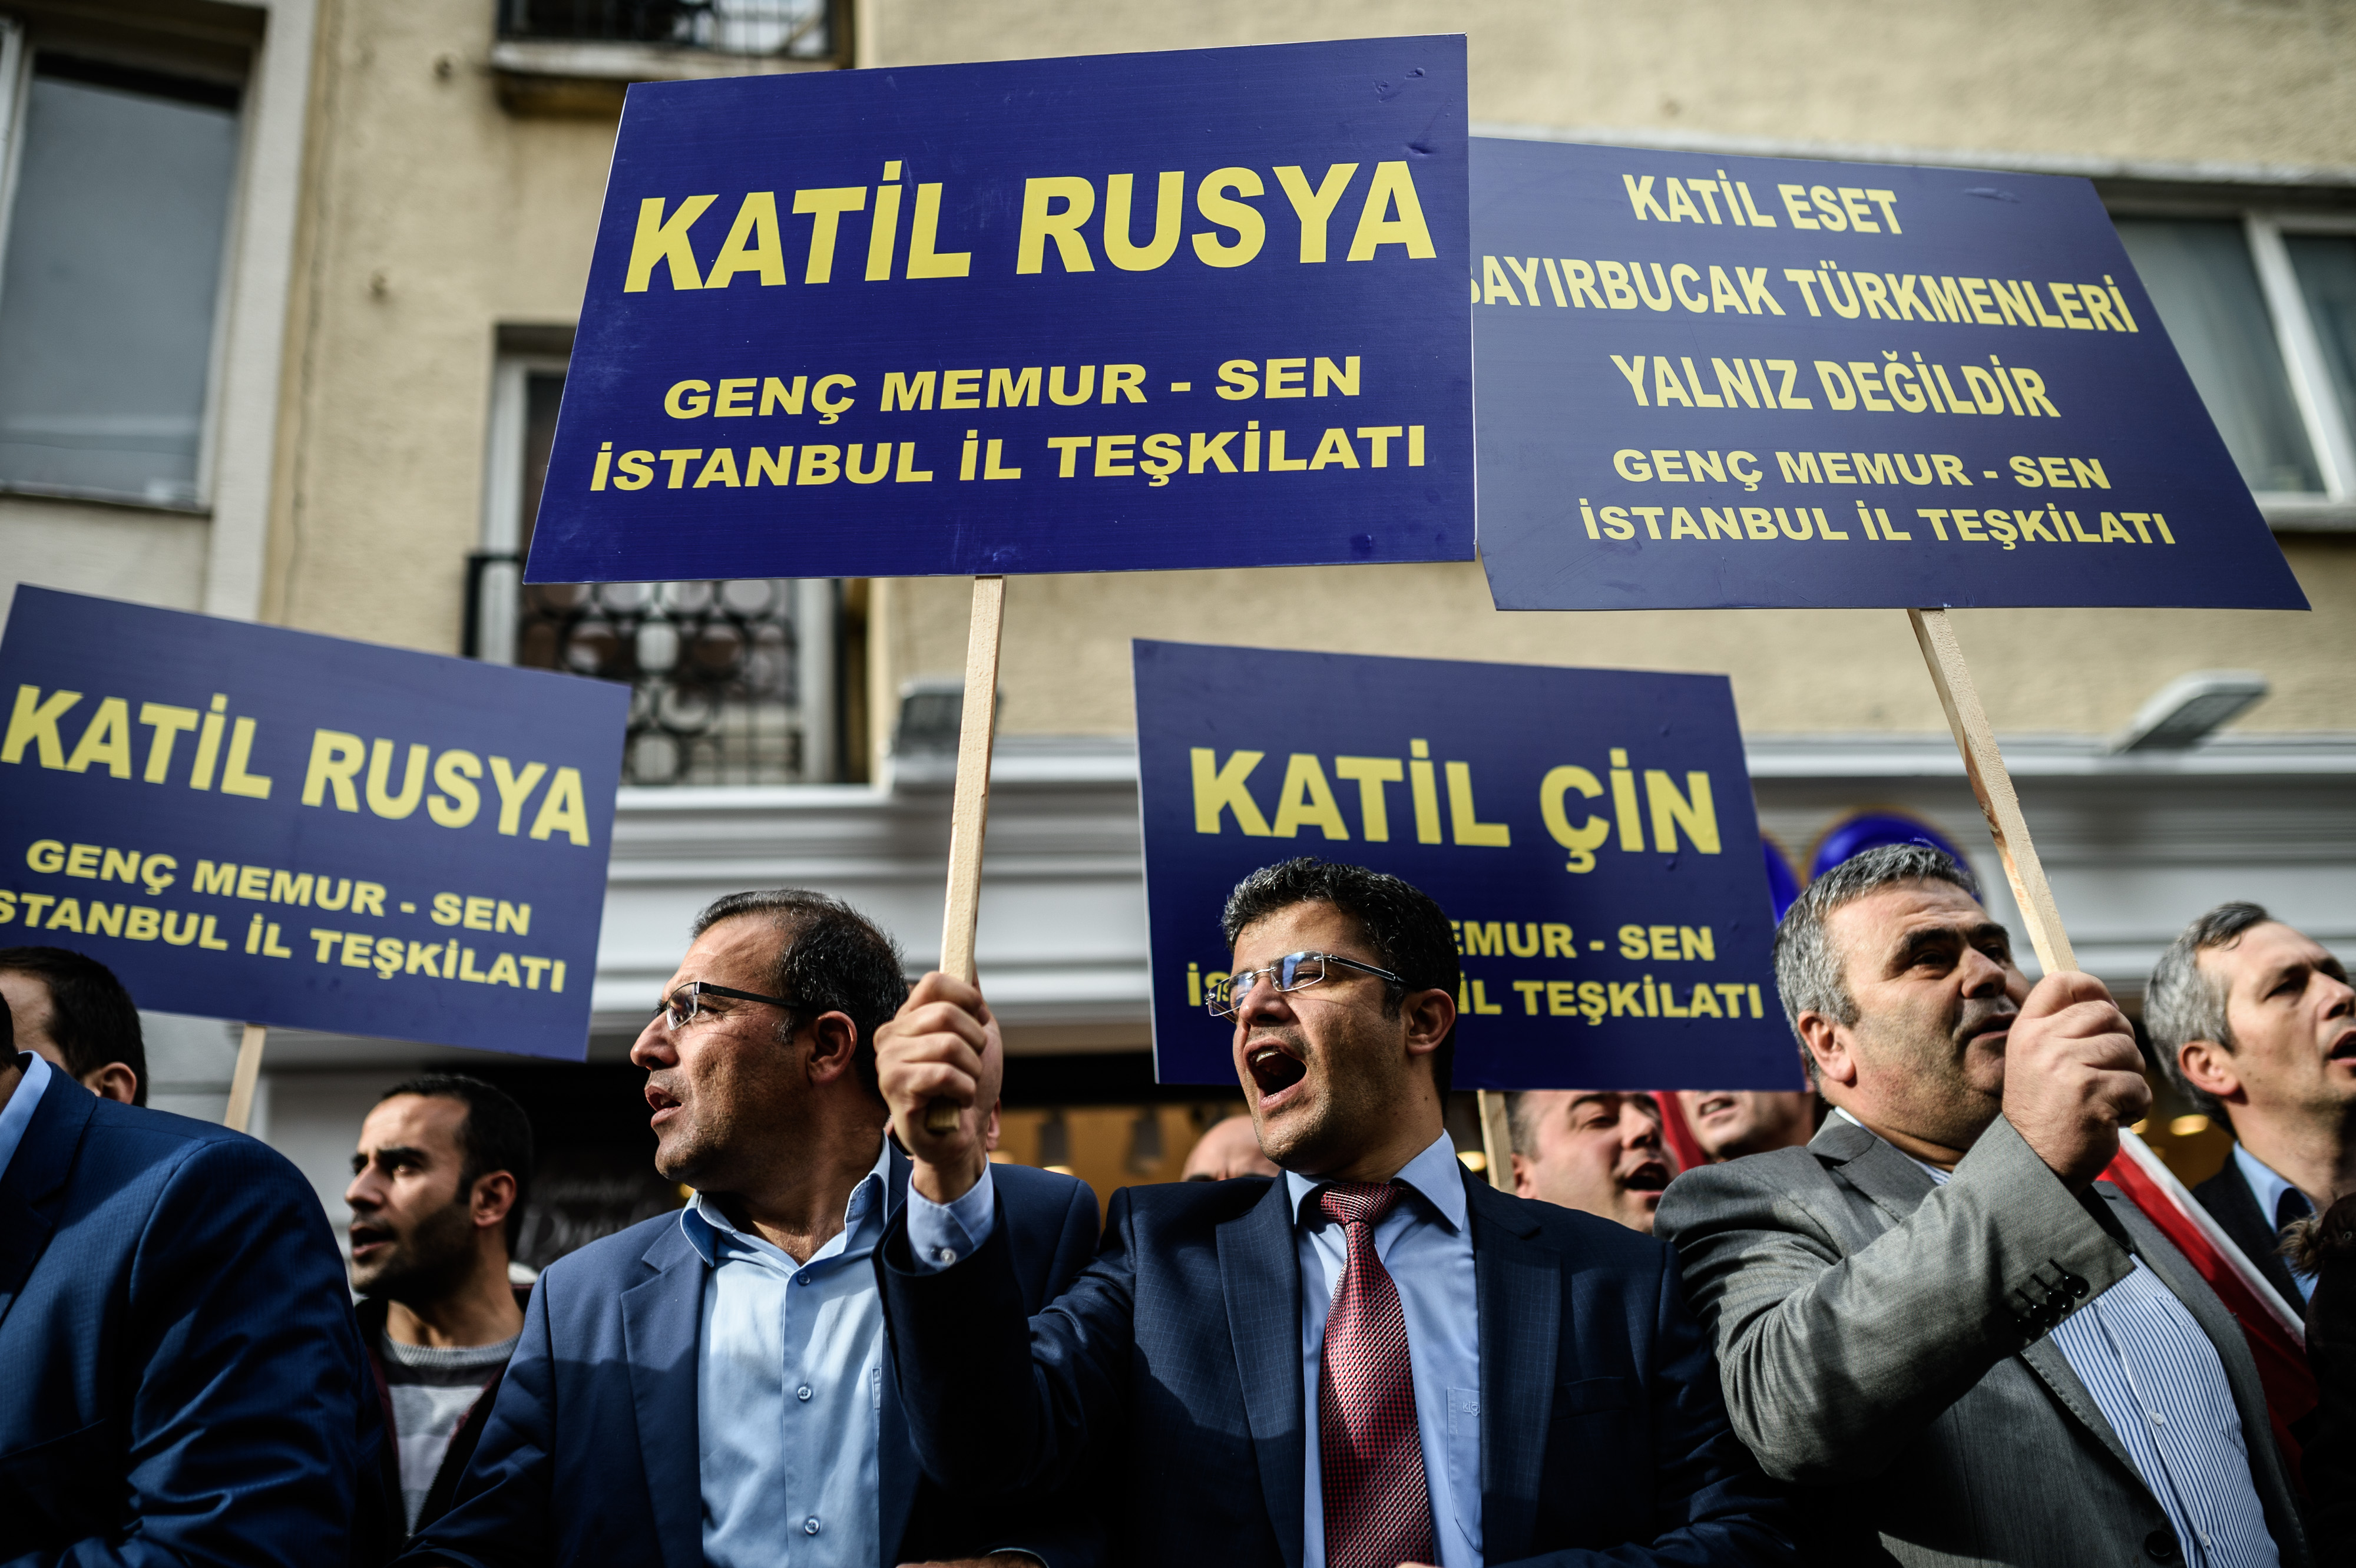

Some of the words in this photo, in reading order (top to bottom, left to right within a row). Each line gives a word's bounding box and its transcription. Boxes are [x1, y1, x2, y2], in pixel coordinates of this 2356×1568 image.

[623, 160, 972, 293] KATİL
[1015, 160, 1437, 275] RUSYA
[1622, 168, 1778, 228] KATİL
[1777, 184, 1902, 234] ESET
[1470, 255, 1786, 316] AYIRBUCAK
[1783, 259, 2139, 333] TÜRKMENLERİ
[663, 373, 857, 425] GENÇ
[879, 363, 1148, 412] MEMUR
[1170, 381, 1192, 393] -
[1215, 355, 1361, 401] SEN
[1609, 354, 1814, 410] YALNIZ
[1813, 349, 2062, 418] DEĞİLDİR
[590, 441, 934, 492] İSTANBUL
[959, 429, 1023, 481] İL
[1047, 419, 1425, 488] TEŞKİLATI
[1612, 448, 1763, 492] GENÇ
[1774, 451, 1974, 487] MEMUR
[1983, 470, 1999, 479] -
[2008, 455, 2112, 489] SEN
[1579, 497, 1850, 541] İSTANBUL
[1856, 499, 1912, 542] İL
[1915, 501, 2176, 551] TEŞKİLATI
[0, 684, 272, 799] KATİL
[301, 729, 590, 846] RUSYA
[1190, 739, 1511, 848] KATİL
[1539, 747, 1722, 874] ÇİN
[26, 839, 177, 895] GENÇ
[191, 859, 386, 917] MEMUR
[400, 902, 416, 914] -
[430, 892, 531, 936] SEN
[0, 889, 229, 951] STANBUL
[244, 913, 292, 959] İL
[310, 928, 566, 993] TEŞKİLATI
[1450, 920, 1577, 958] MUR
[1589, 940, 1606, 951] -
[1617, 924, 1716, 961] SEN
[1513, 974, 1764, 1026] TEŞKİLATI
